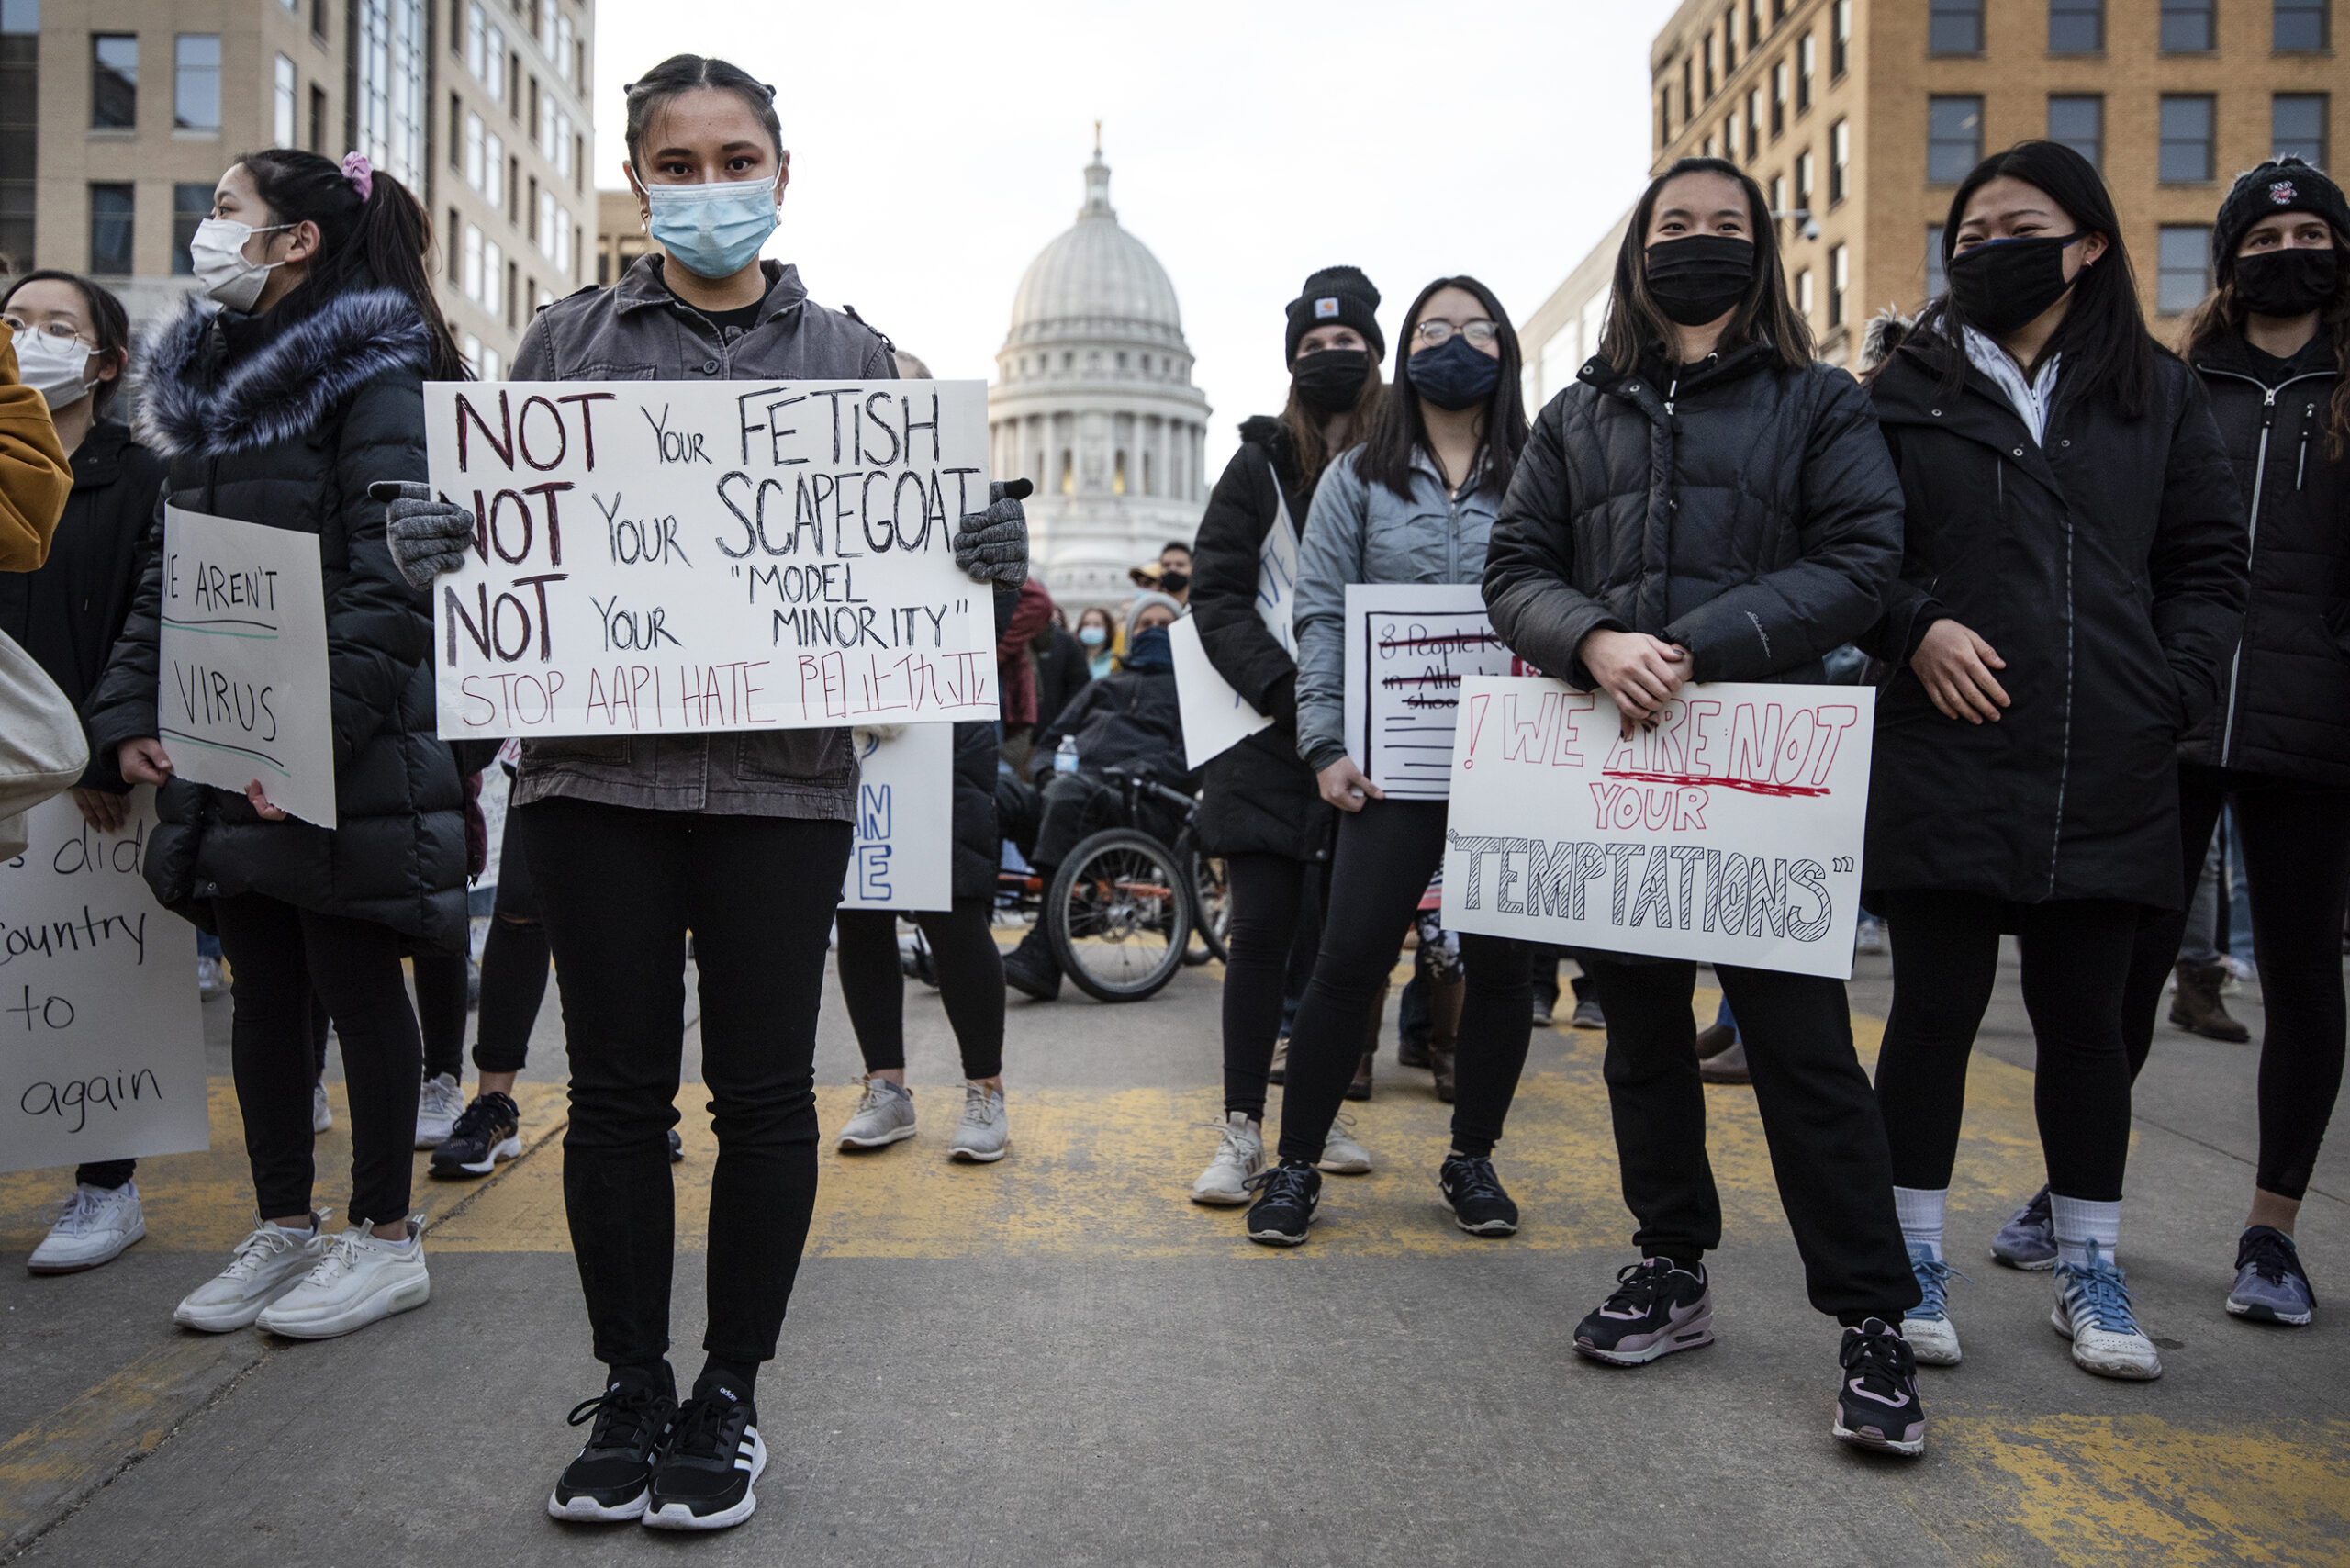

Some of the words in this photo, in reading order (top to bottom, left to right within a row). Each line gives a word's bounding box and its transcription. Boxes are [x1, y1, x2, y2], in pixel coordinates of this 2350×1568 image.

[456, 389, 616, 472] NOT
[735, 386, 940, 467] FETISH
[591, 490, 694, 568] YOUR
[716, 467, 981, 558] SCAPEGOAT
[196, 561, 277, 611] AREN'T
[731, 563, 868, 606] "MODEL
[445, 573, 570, 668] NOT
[590, 594, 685, 651] YOUR
[772, 599, 969, 649] MINORITY"
[1380, 623, 1396, 660] 8
[1408, 623, 1474, 668] People
[174, 660, 276, 742] VIRUS
[461, 667, 565, 729] STOP
[586, 665, 662, 731] AAPI
[680, 660, 778, 728] HATE
[1503, 692, 1595, 767] WE
[1603, 698, 1722, 778] ARE
[1727, 702, 1858, 787] NOT
[1590, 782, 1710, 831] YOUR
[53, 818, 143, 874] did
[0, 905, 146, 965] ountry
[6, 985, 74, 1031] to
[20, 1068, 162, 1134] again
